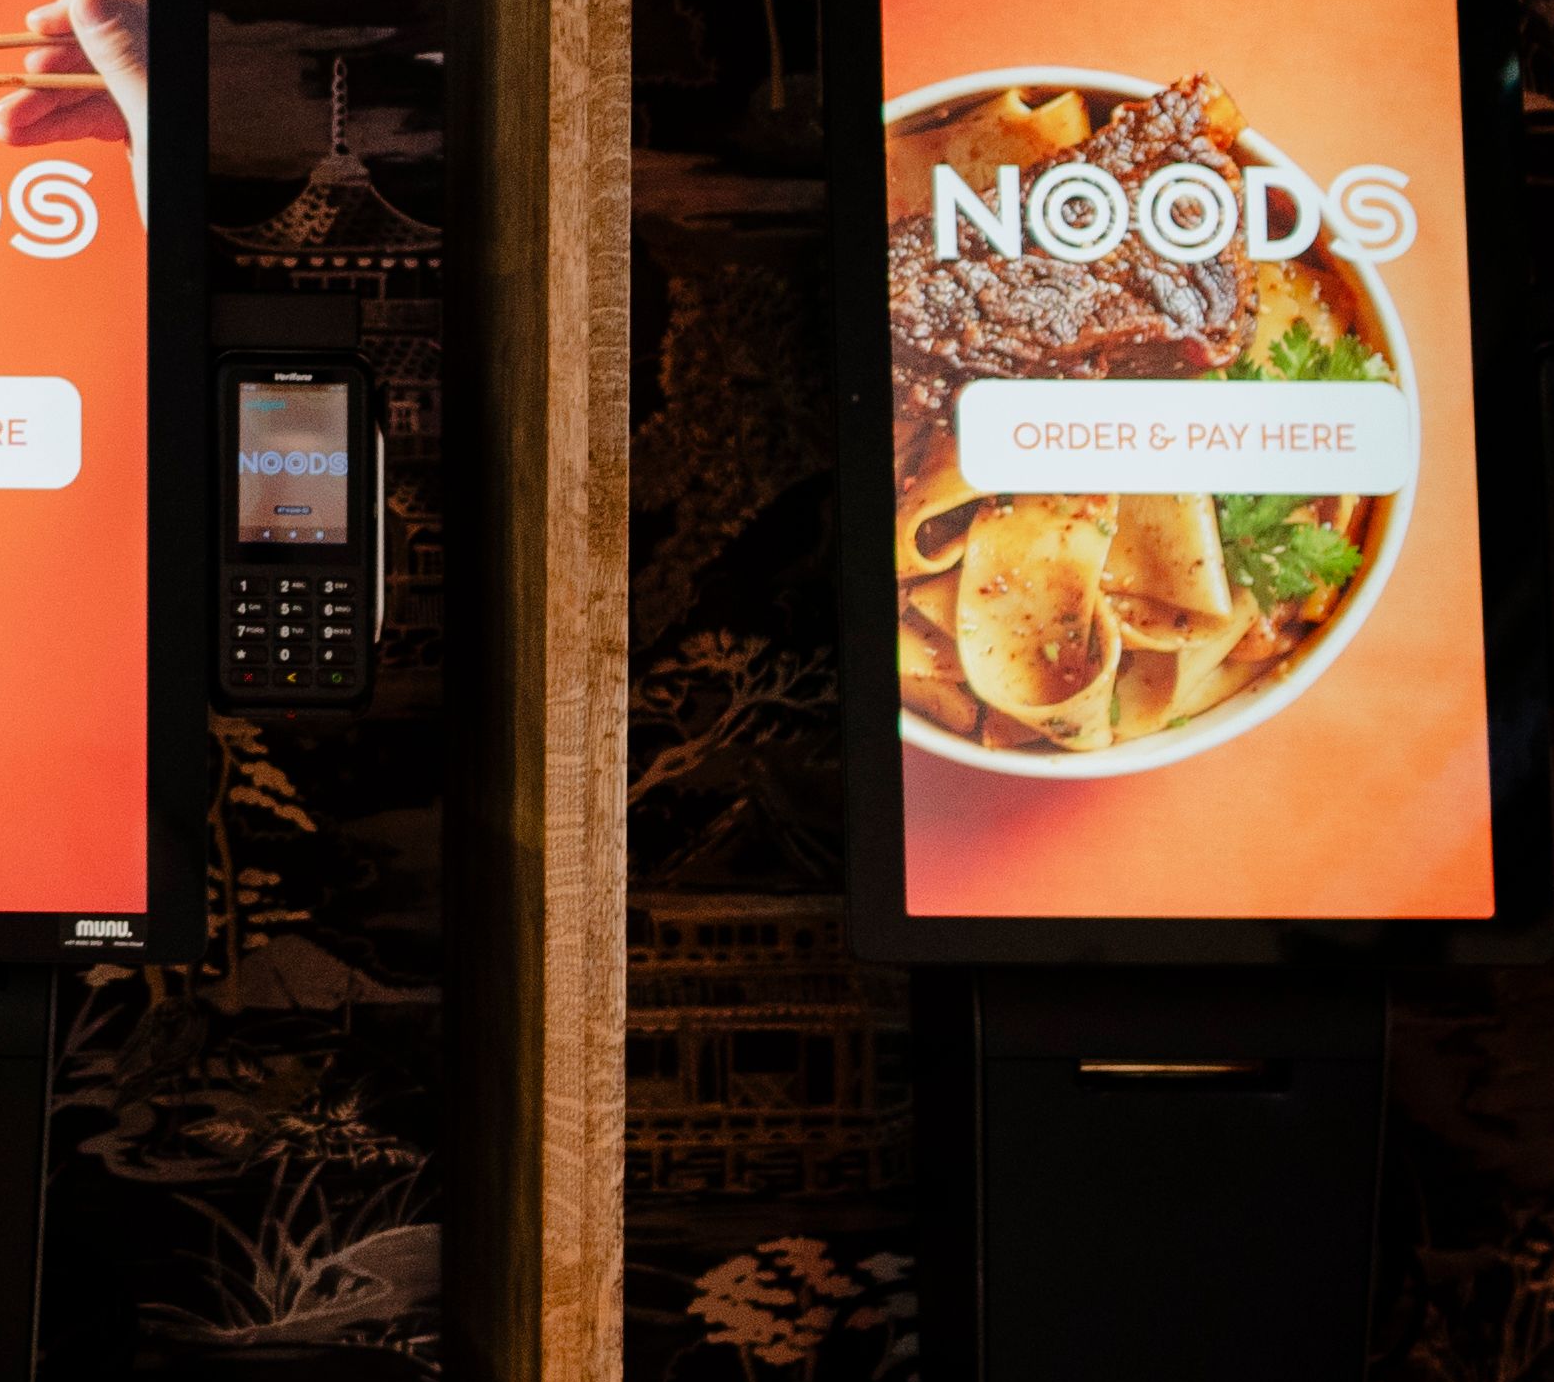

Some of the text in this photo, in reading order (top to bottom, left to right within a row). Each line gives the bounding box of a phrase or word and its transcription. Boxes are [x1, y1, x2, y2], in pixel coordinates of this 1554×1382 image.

[933, 162, 1418, 264] NOODS
[1013, 422, 1357, 452] ORDER & PAY HERE
[239, 451, 348, 476] NOODS
[241, 580, 247, 592] 1
[280, 580, 290, 593] 2
[324, 581, 334, 593] 3
[237, 603, 246, 615] 4
[280, 603, 290, 615] 5
[324, 604, 334, 616] 6
[237, 625, 246, 637] 7
[280, 625, 290, 638] 8
[324, 626, 334, 639] 9
[280, 648, 290, 661] 0
[75, 919, 133, 938] munu.
